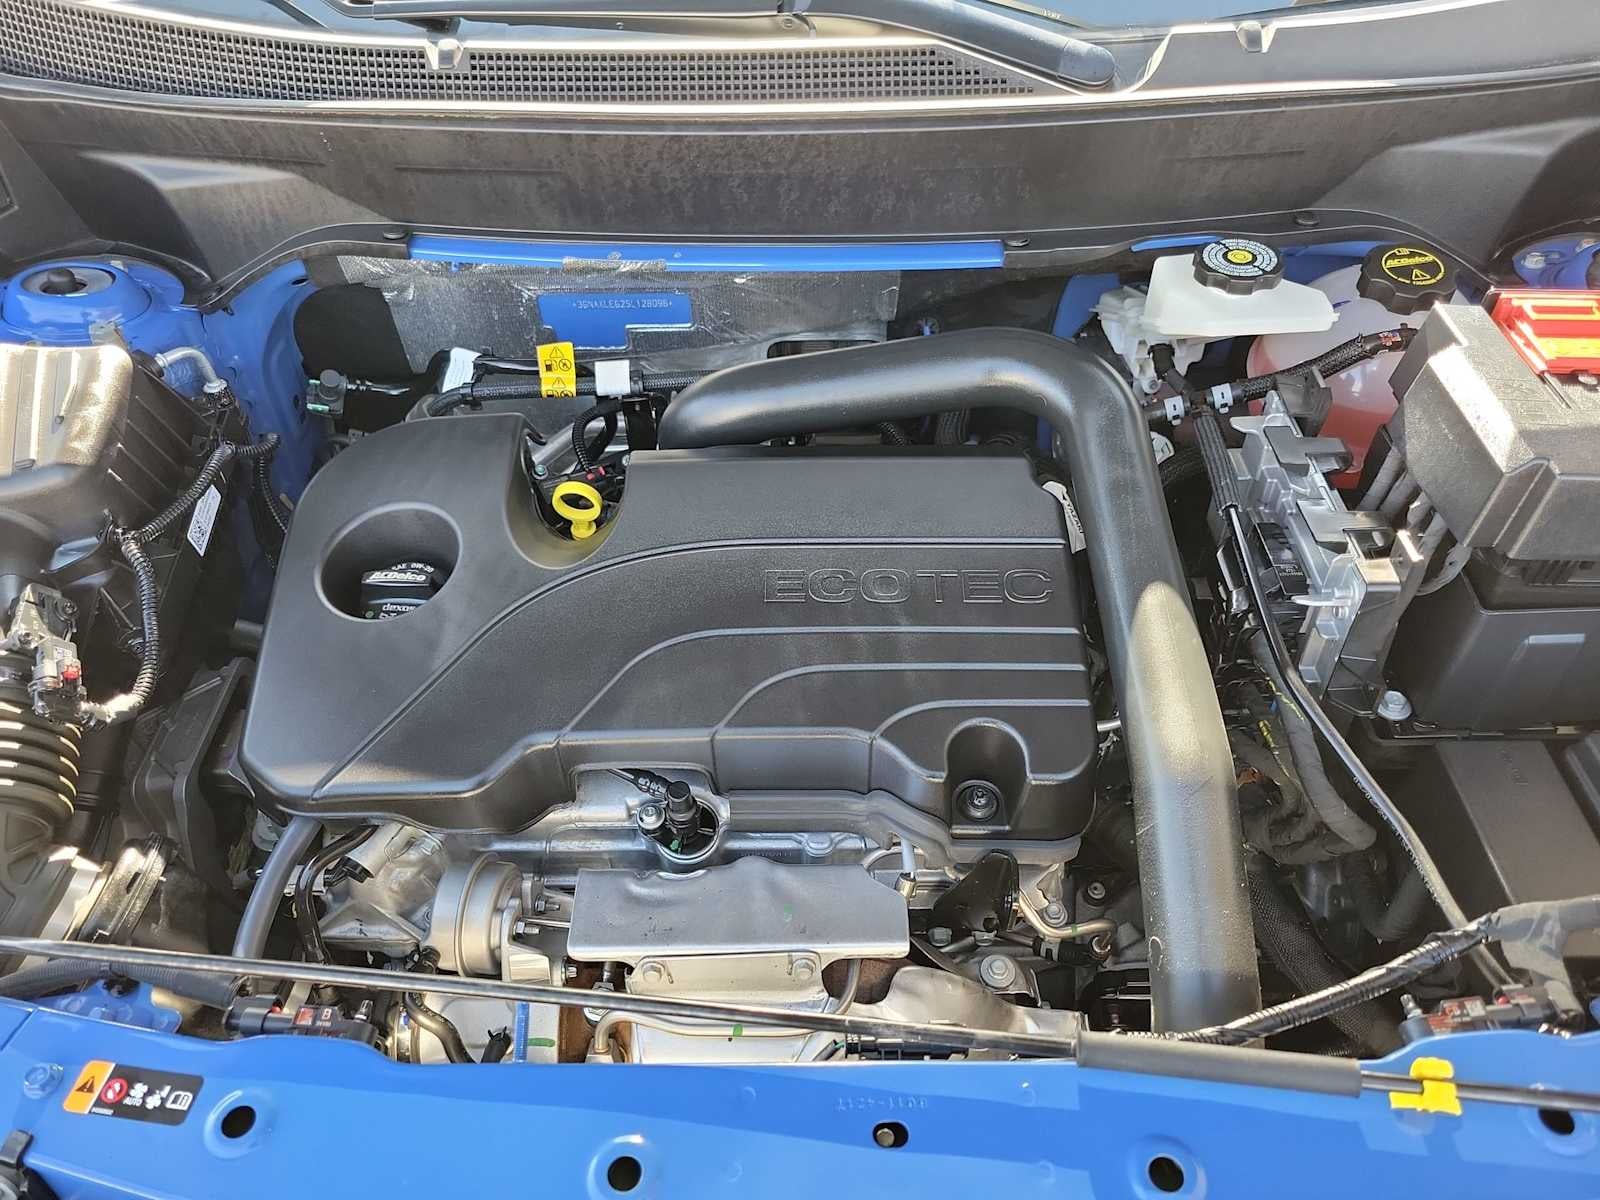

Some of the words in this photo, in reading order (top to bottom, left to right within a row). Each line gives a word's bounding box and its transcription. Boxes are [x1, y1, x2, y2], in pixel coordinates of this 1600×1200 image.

[367, 571, 427, 582] ACDelco
[763, 569, 1054, 604] ECOTEC
[123, 1096, 144, 1107] AUTO
